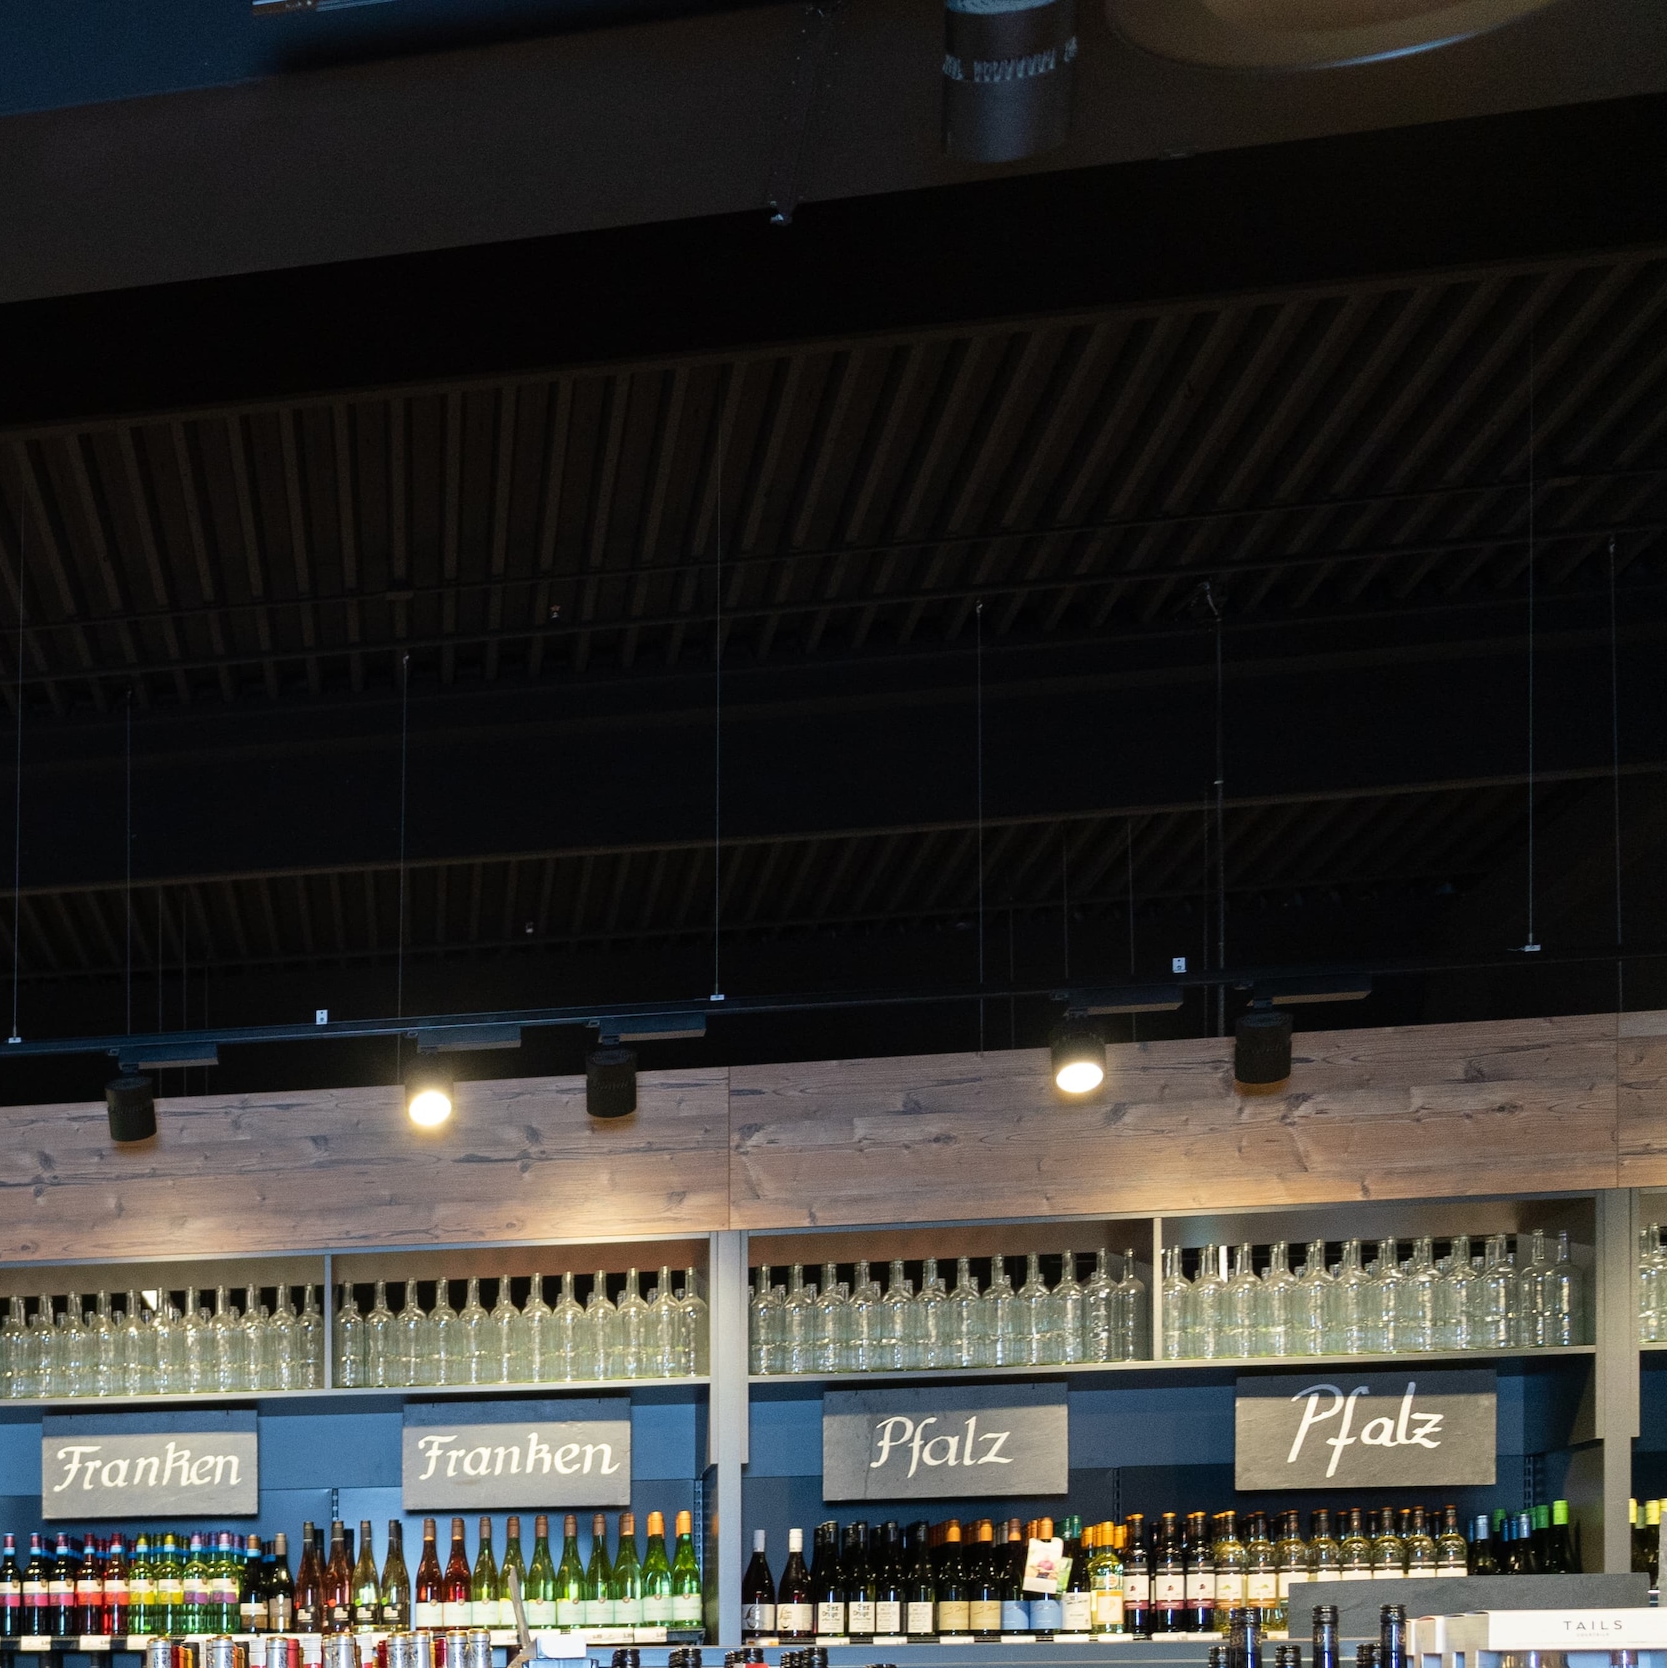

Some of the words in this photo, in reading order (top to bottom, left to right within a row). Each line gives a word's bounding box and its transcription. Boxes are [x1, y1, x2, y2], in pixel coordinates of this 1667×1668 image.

[869, 1416, 1013, 1477] Pfalz
[1287, 1381, 1444, 1478] Pfalz
[53, 1441, 241, 1493] Franken
[417, 1432, 621, 1481] Franken
[1564, 1620, 1623, 1630] TAILS
